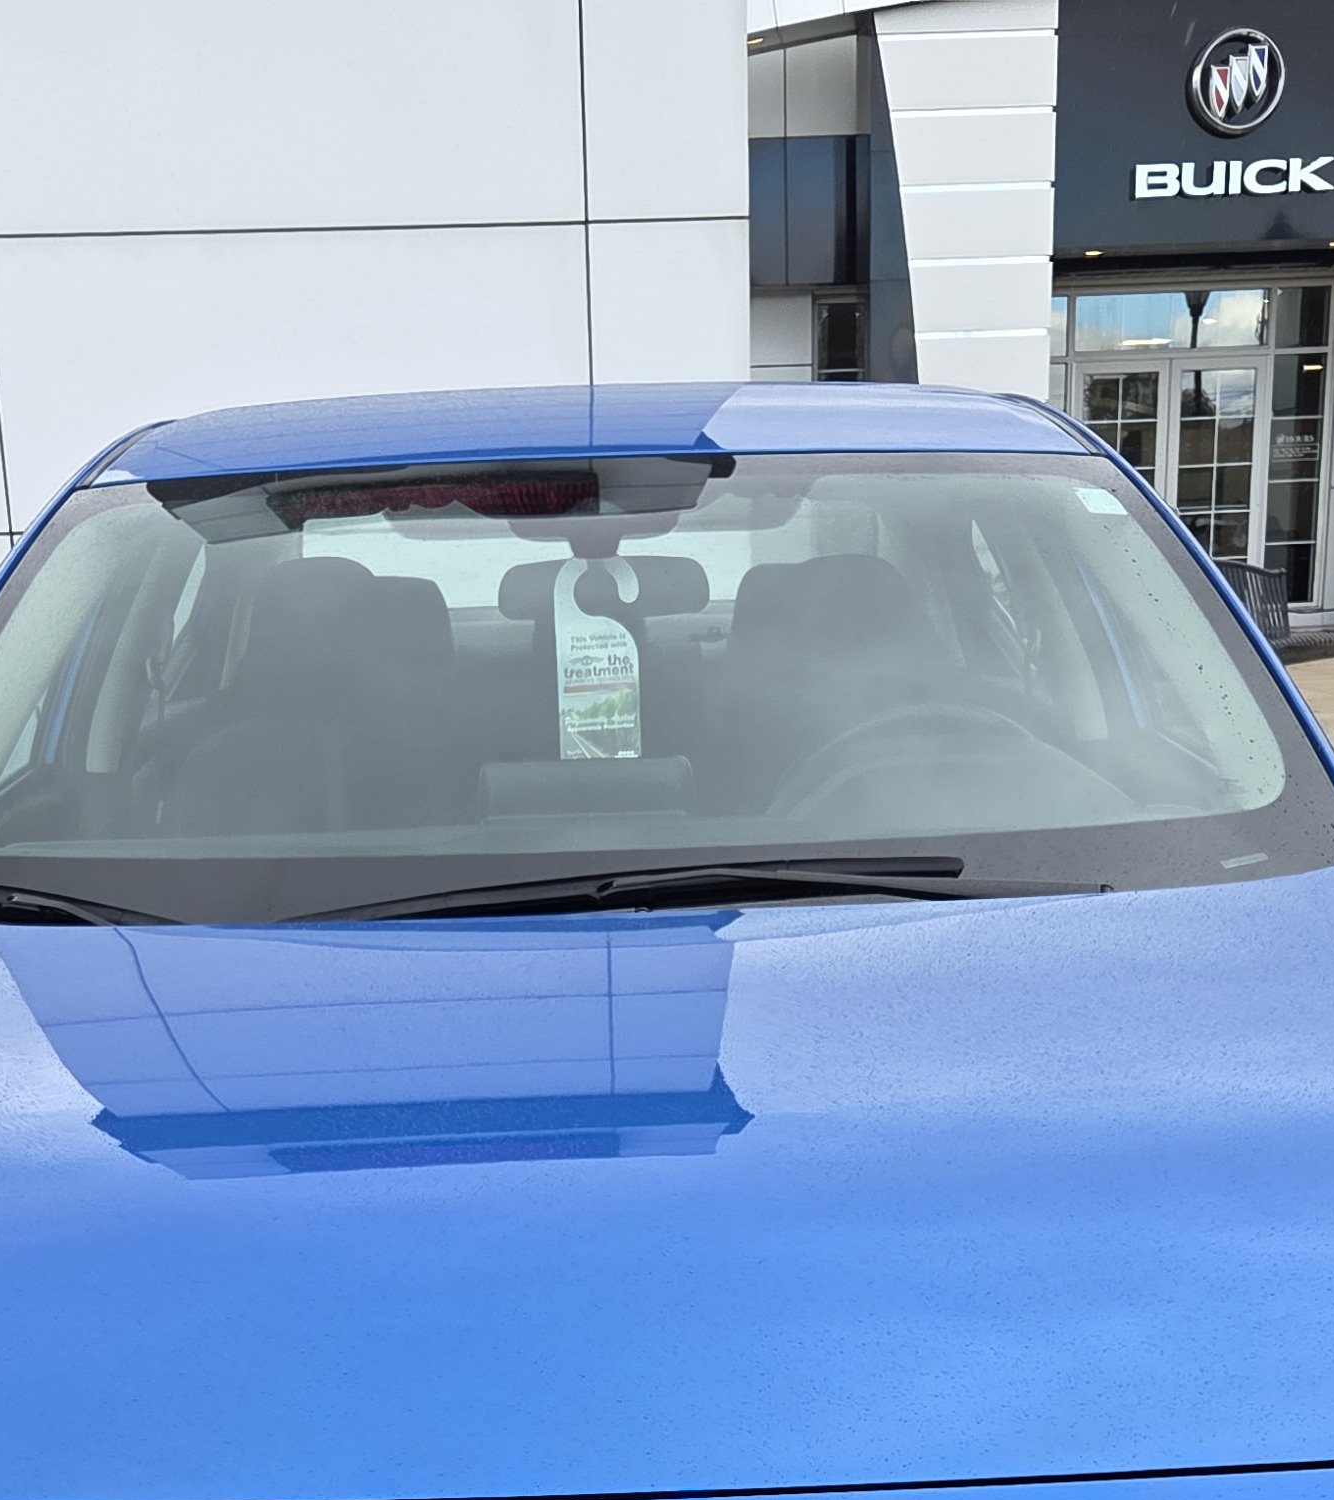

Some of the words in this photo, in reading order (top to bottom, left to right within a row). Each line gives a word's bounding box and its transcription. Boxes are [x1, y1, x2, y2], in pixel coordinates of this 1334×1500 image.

[1134, 156, 1334, 199] BUICK
[571, 635, 587, 644] This
[607, 653, 631, 666] the
[563, 662, 635, 680] treatment
